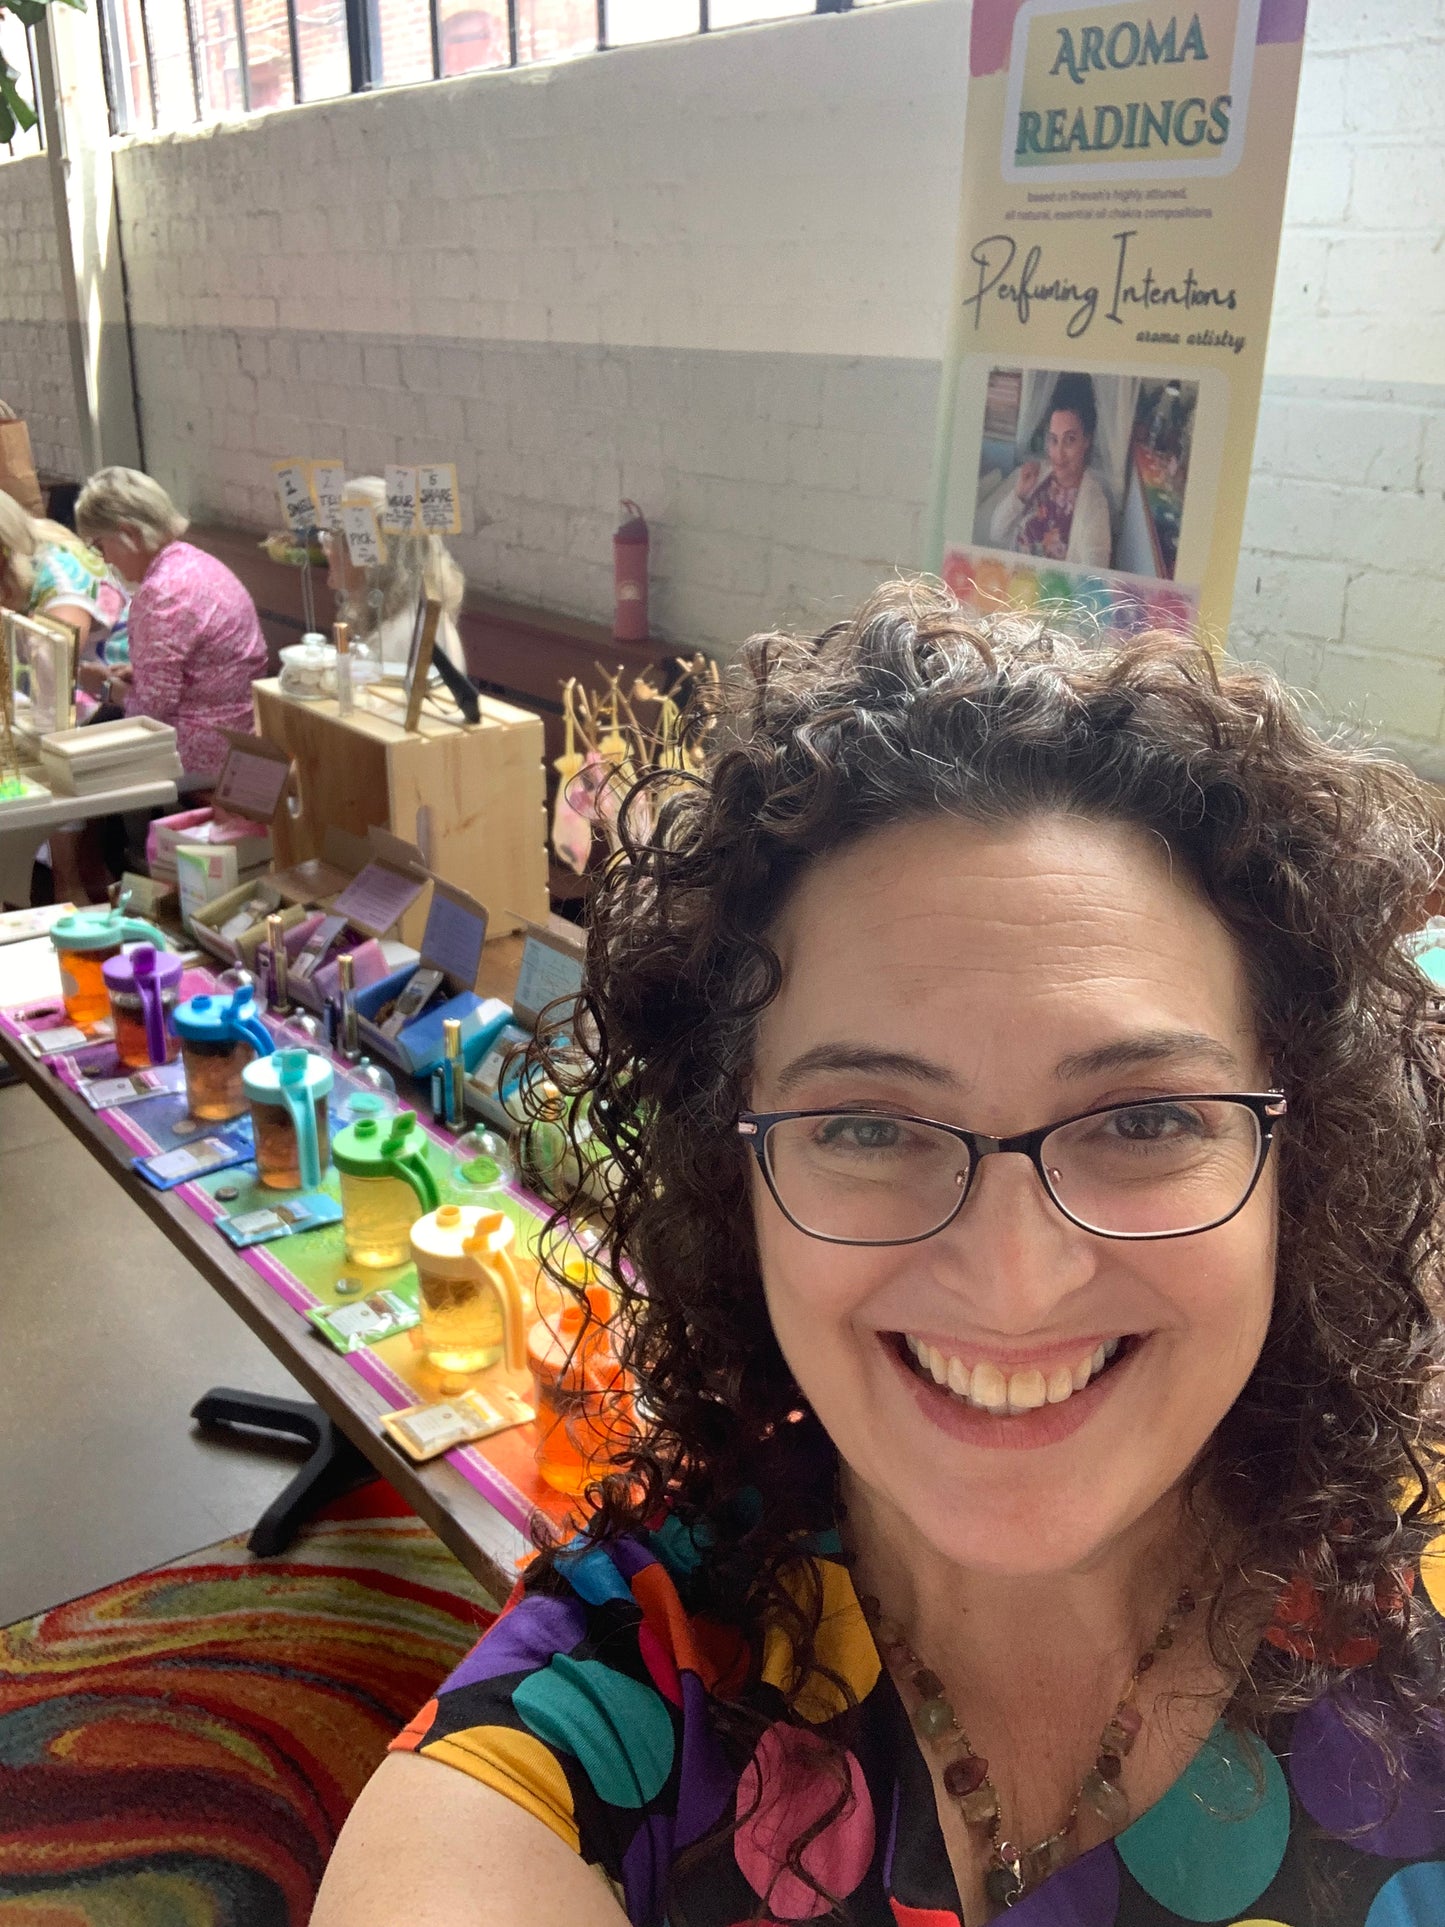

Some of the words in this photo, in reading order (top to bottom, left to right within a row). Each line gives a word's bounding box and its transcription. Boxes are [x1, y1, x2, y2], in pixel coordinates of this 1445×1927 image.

[1049, 12, 1209, 84] AROMA
[1014, 95, 1233, 155] READINGS
[962, 234, 1100, 339] Perfuming
[1105, 230, 1237, 324] Intentions
[1136, 330, 1180, 345] aroma
[1186, 329, 1246, 355] artistry
